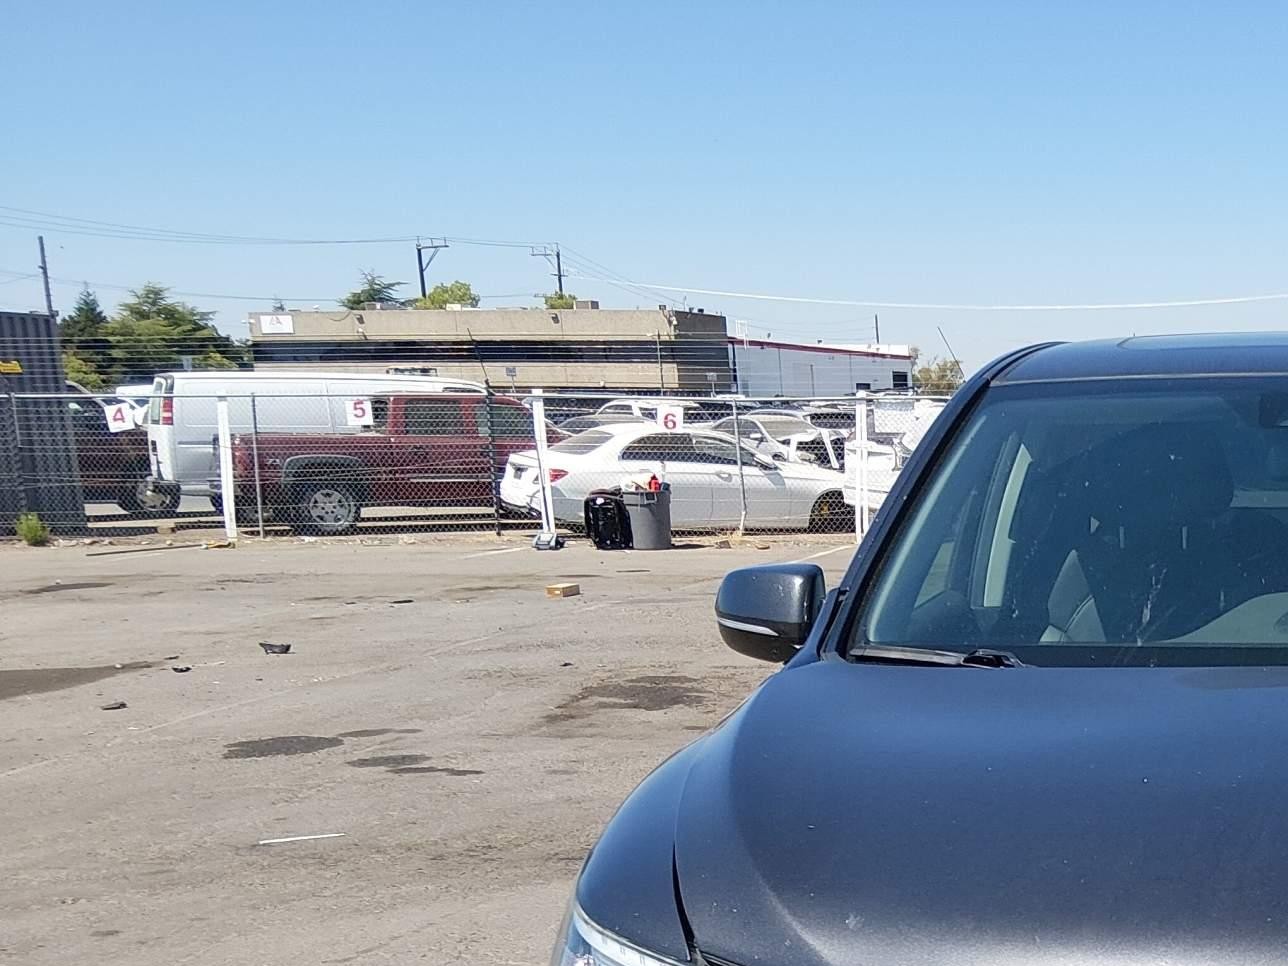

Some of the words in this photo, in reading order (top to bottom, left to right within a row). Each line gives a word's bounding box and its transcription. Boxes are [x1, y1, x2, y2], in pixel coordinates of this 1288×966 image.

[112, 406, 126, 423] 4
[353, 400, 366, 418] 5
[663, 413, 677, 430] 6
